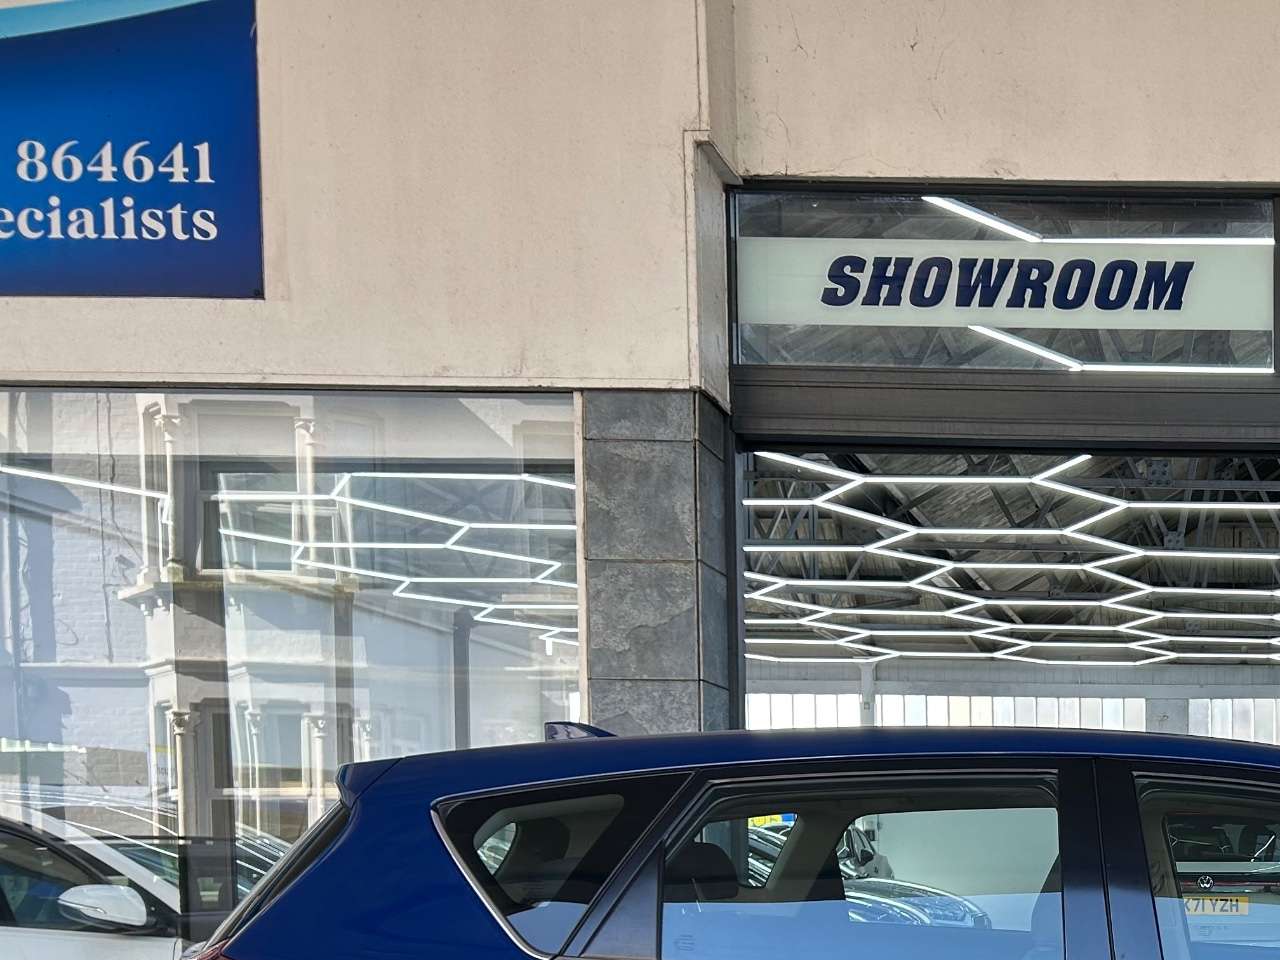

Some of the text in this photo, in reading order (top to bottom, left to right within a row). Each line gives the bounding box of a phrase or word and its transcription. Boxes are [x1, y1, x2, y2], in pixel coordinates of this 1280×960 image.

[16, 140, 216, 184] 864641
[820, 255, 1195, 311] SHOWROOM
[1207, 898, 1240, 913] YZH
